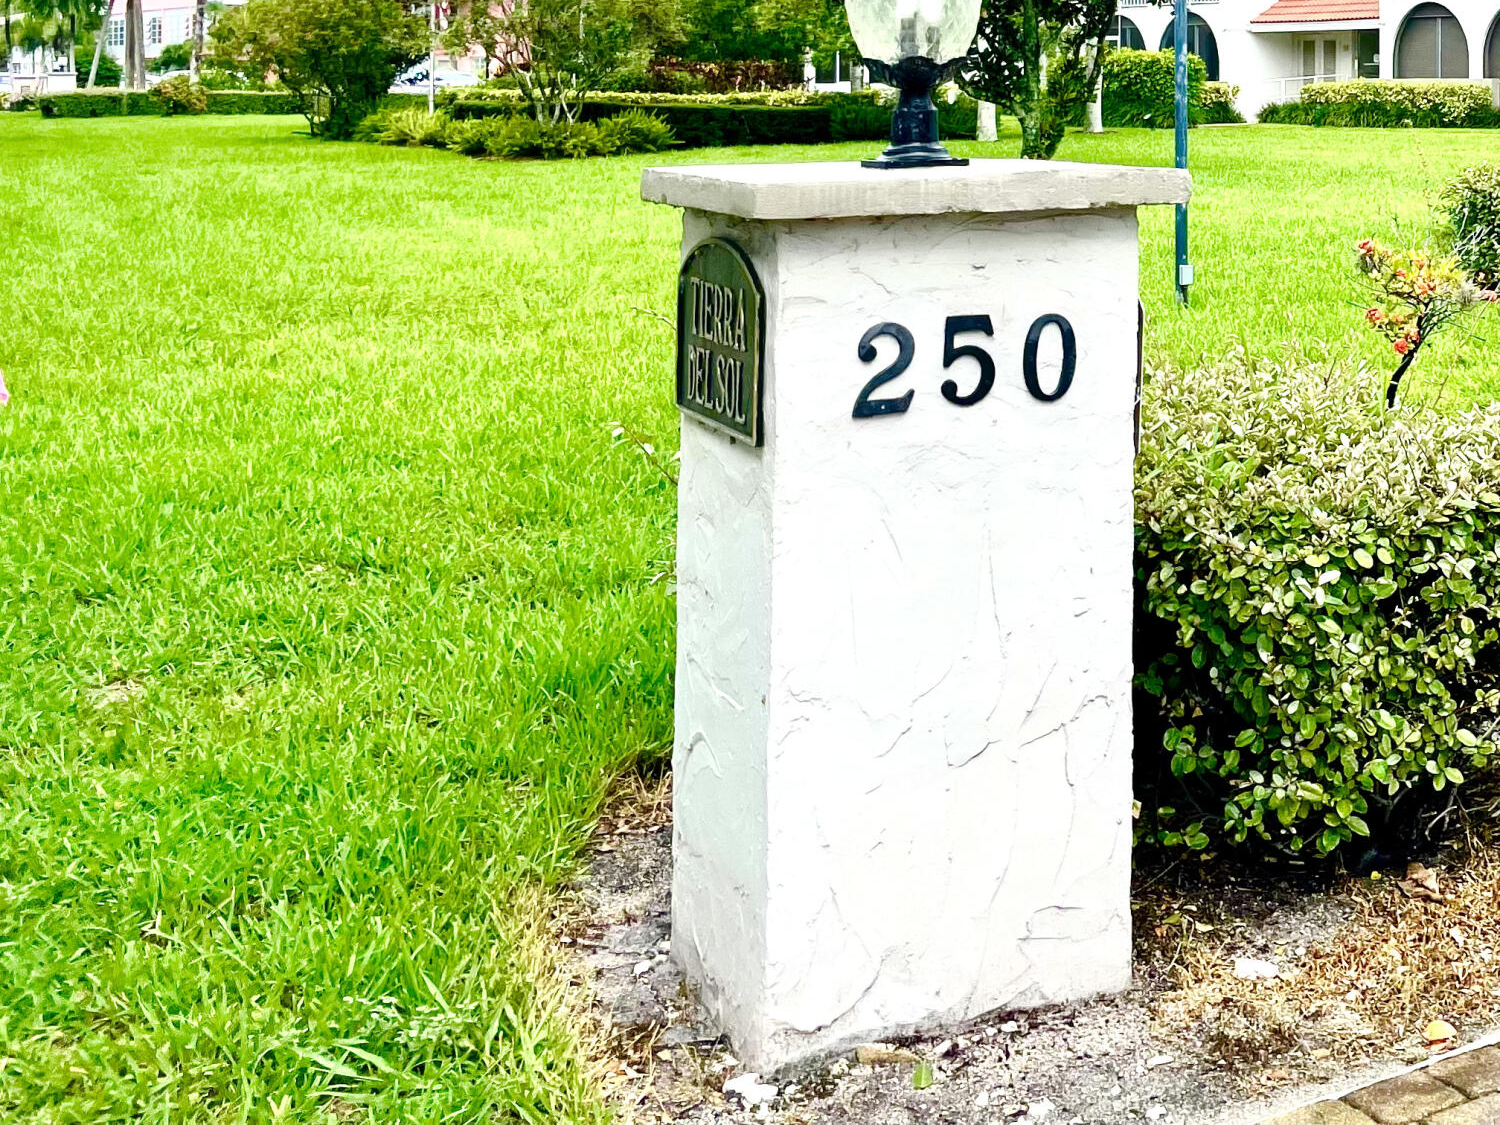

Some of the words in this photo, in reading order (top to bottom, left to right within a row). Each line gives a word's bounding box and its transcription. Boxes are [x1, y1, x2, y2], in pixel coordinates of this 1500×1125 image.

[690, 277, 746, 352] TIERRA
[687, 345, 713, 409] DEL
[715, 354, 745, 423] SOL
[852, 313, 1076, 418] 250
